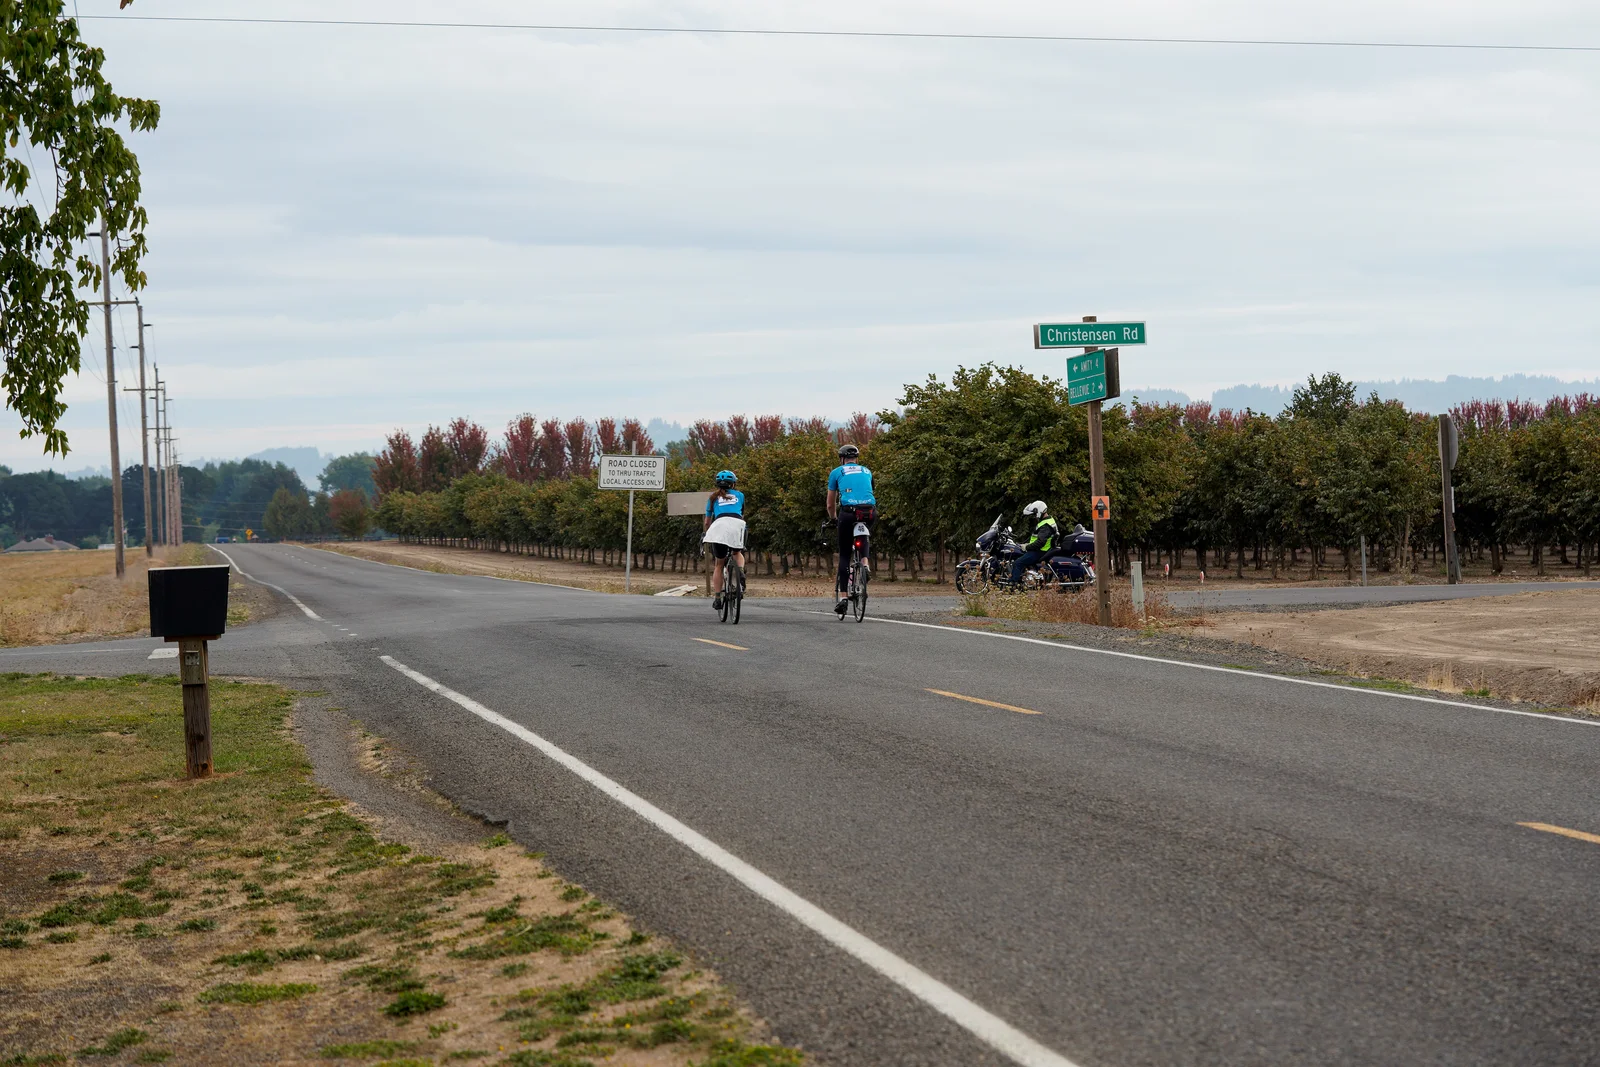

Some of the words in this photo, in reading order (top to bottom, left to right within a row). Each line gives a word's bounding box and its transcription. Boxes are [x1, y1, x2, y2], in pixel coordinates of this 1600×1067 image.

[1047, 328, 1116, 342] Christensen
[1123, 327, 1138, 340] Rd
[608, 459, 628, 468] ROAD
[630, 460, 657, 468] CLOSED
[646, 479, 662, 487] ONLY
